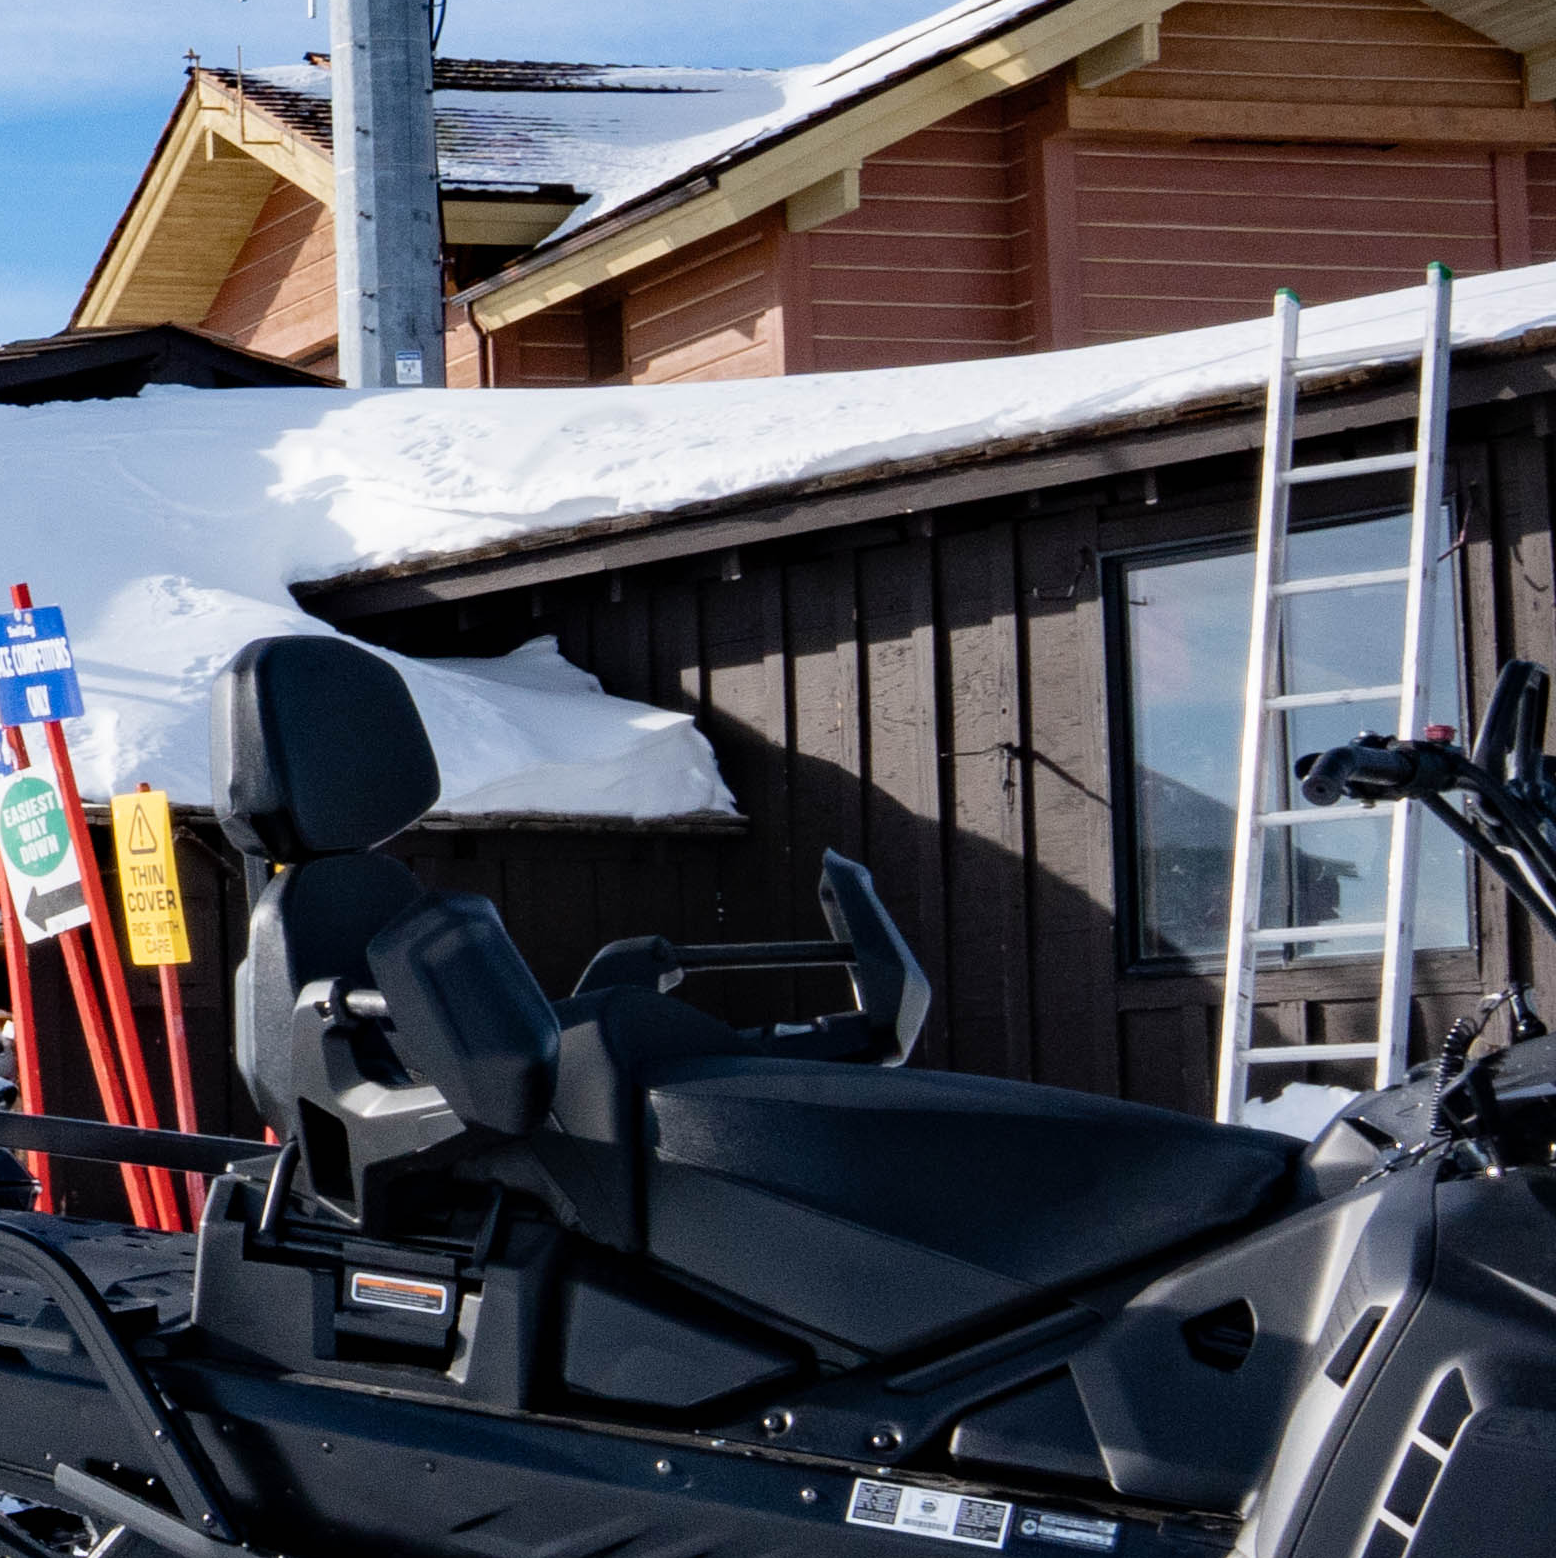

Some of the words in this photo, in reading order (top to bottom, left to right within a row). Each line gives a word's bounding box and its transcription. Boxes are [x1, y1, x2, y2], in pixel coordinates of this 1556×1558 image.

[12, 637, 72, 677] COMPETITORS
[25, 684, 52, 718] ONLY
[2, 791, 55, 828] EASIEST
[18, 816, 48, 843] WAY
[19, 834, 60, 866] DOWN
[130, 864, 164, 886] THIN
[127, 890, 177, 913] COVER
[131, 923, 152, 937] RIDE
[155, 920, 180, 937] WITH
[145, 939, 172, 955] CARE
